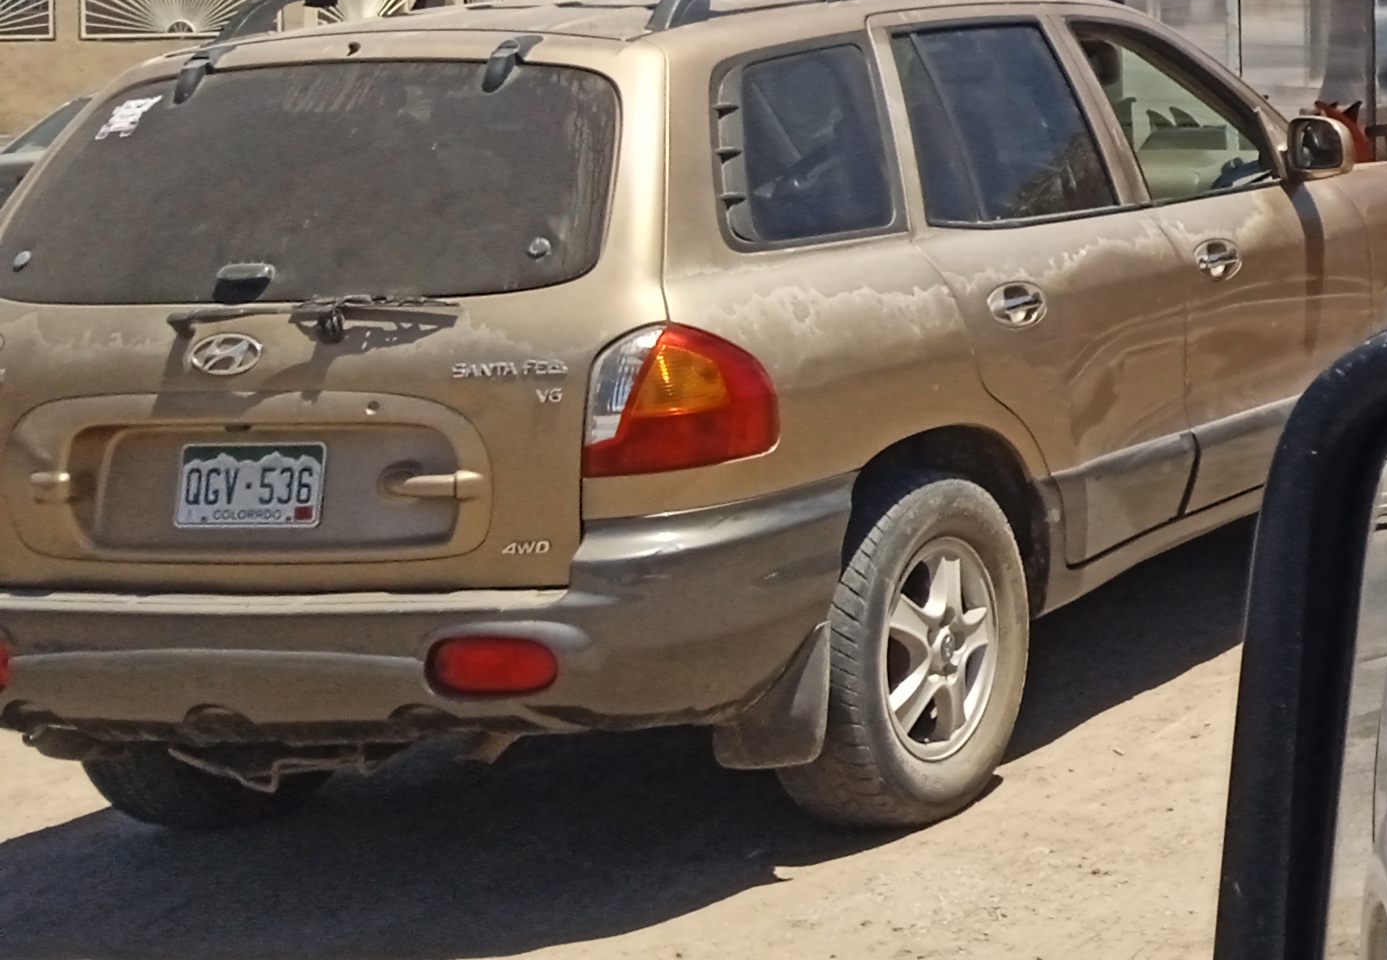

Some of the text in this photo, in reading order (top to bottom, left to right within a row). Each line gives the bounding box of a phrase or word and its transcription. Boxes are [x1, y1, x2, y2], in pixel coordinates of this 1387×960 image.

[452, 361, 518, 378] SANTA
[535, 387, 564, 404] V6
[212, 509, 282, 521] COLORADO
[502, 539, 551, 555] 4WD
